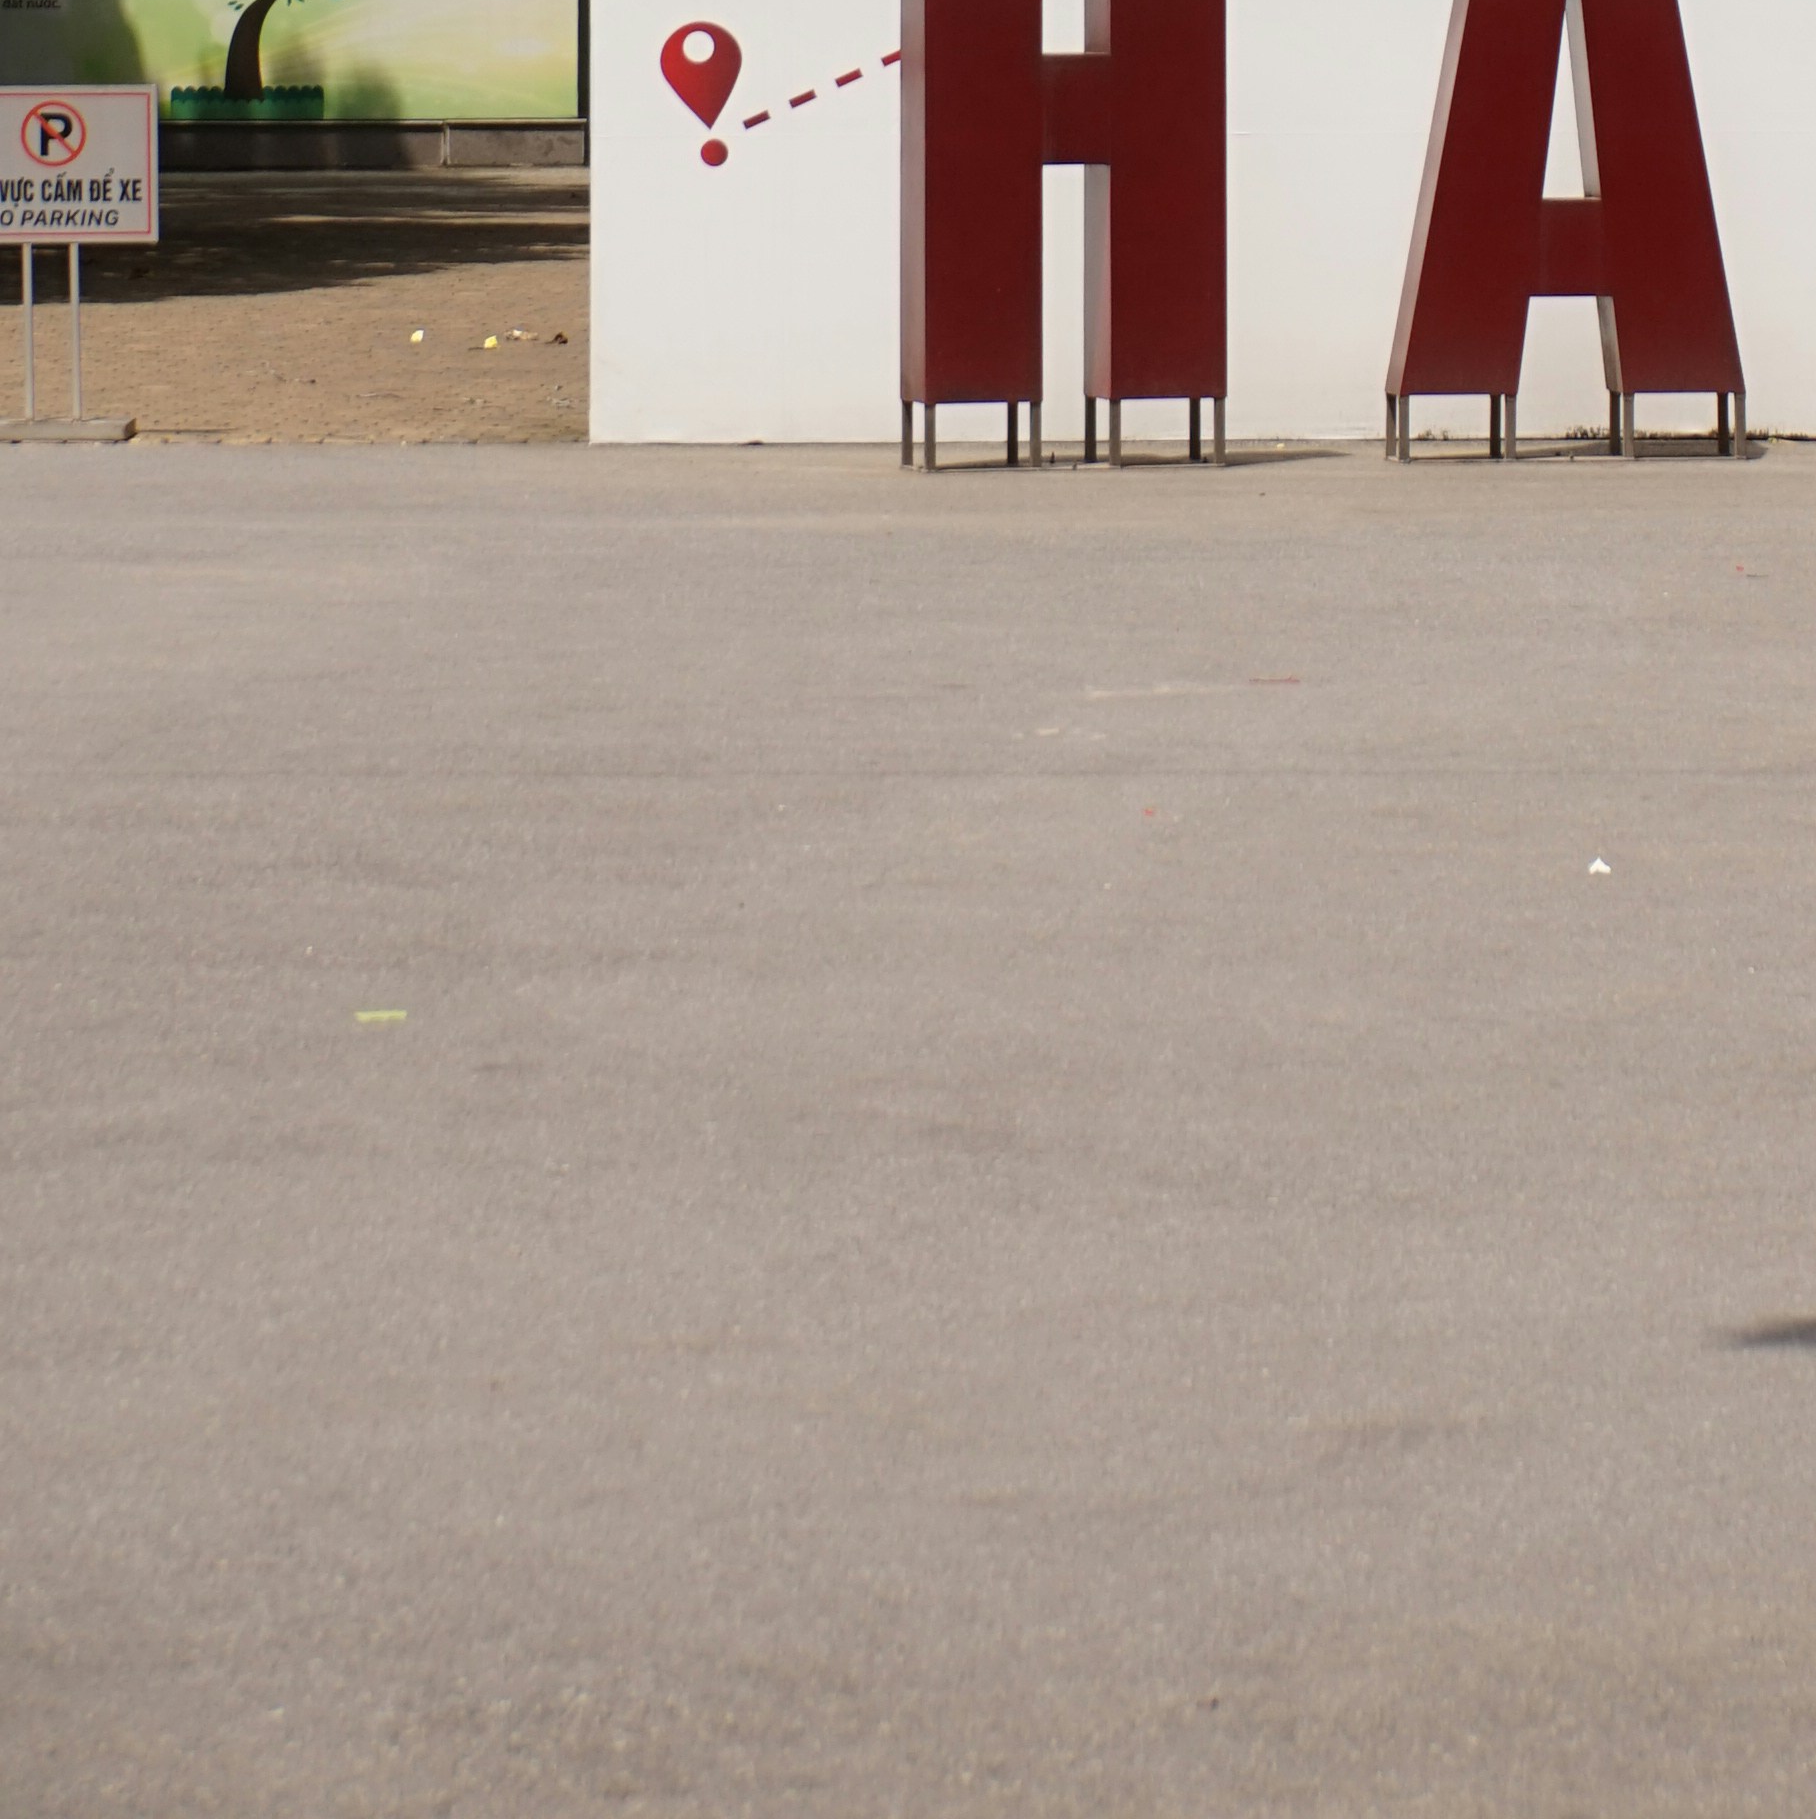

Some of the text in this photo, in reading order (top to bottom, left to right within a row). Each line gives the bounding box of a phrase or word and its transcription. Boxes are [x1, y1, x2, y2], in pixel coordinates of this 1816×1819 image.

[41, 171, 83, 202] CẤM
[89, 167, 115, 202] ĐỂ
[119, 178, 142, 202] XE
[20, 209, 119, 227] PARKING
